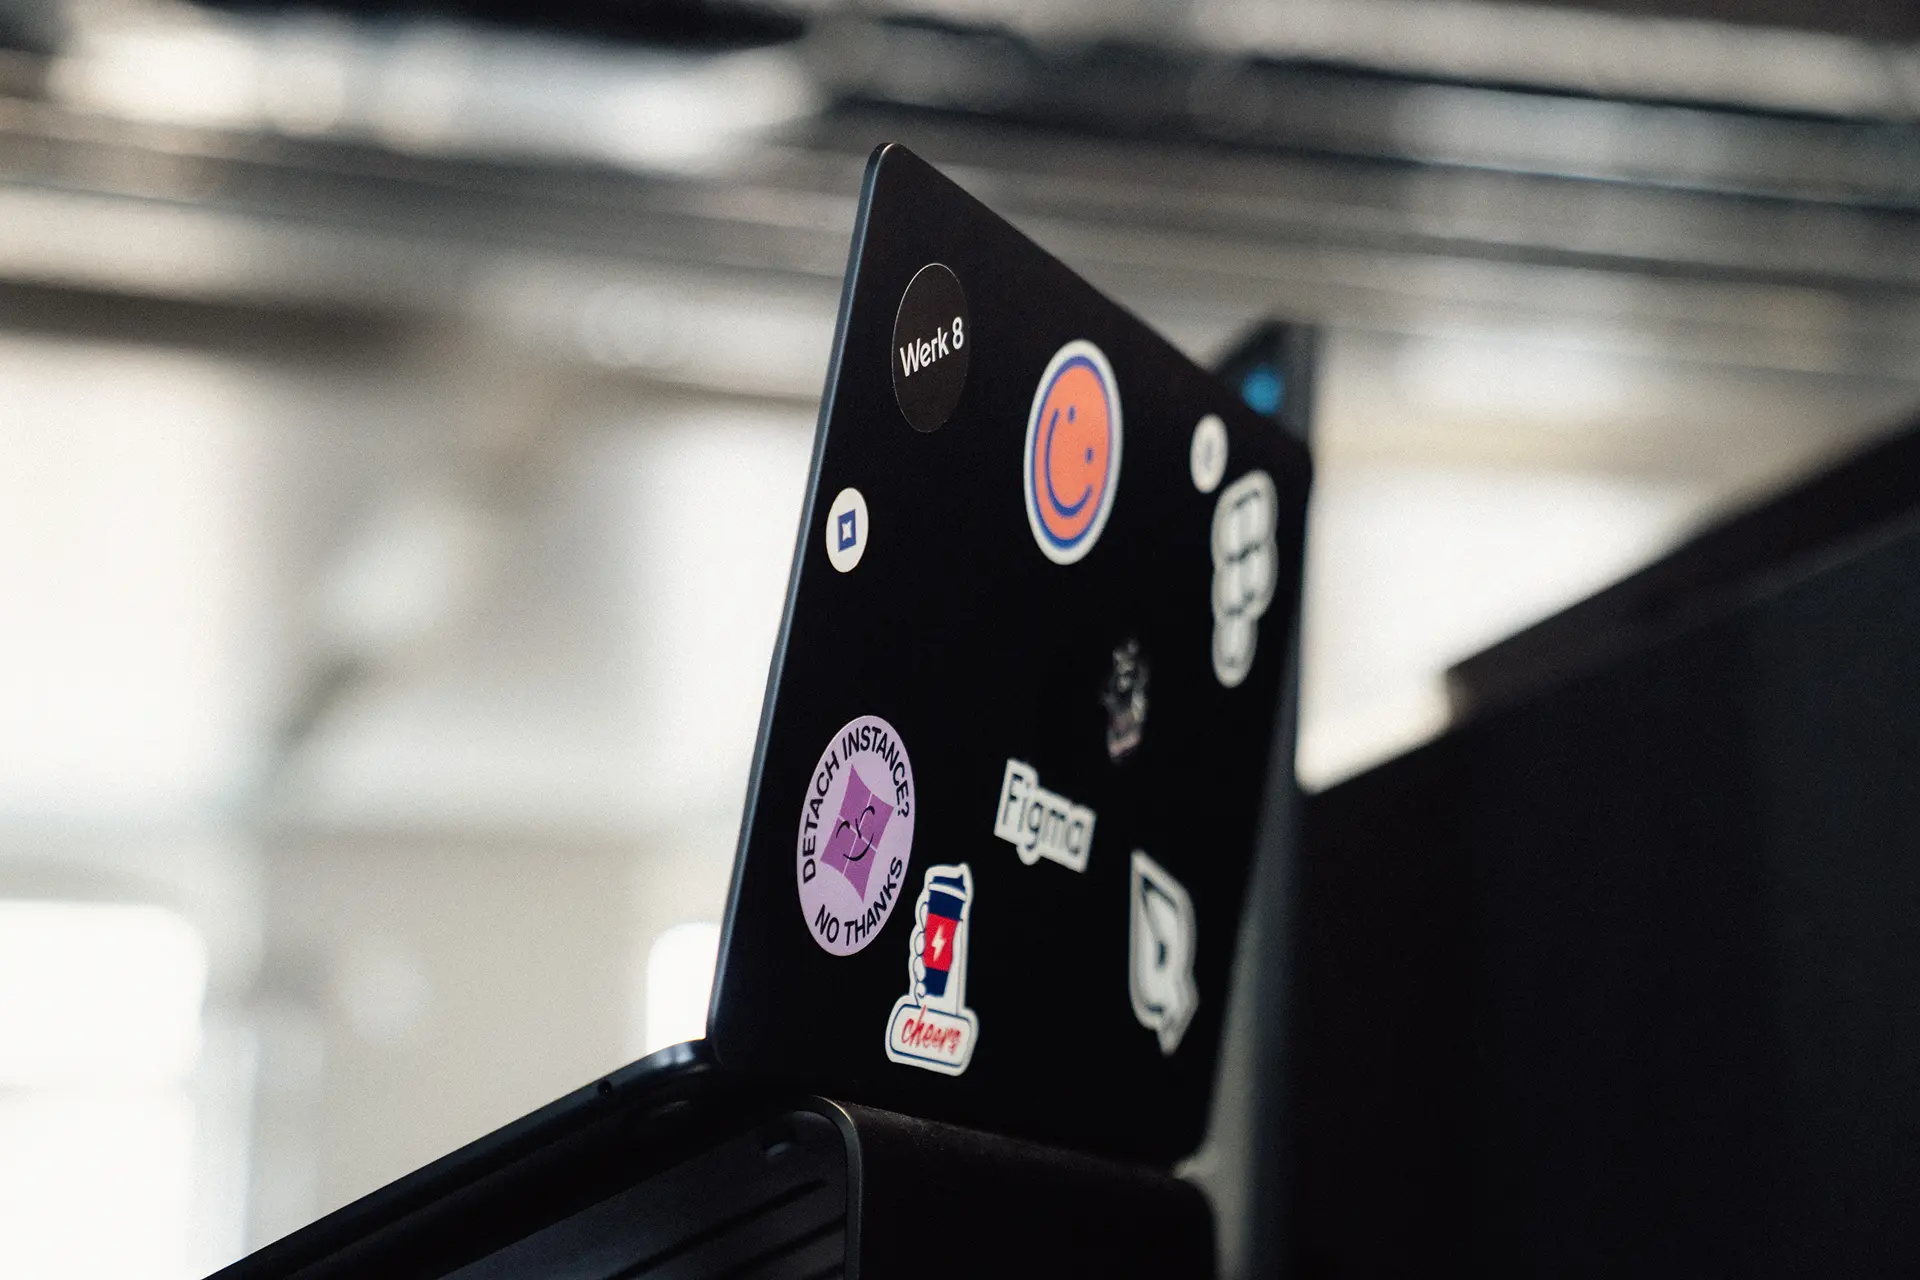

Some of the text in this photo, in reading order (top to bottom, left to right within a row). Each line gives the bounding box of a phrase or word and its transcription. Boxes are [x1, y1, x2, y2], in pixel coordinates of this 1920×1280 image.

[900, 316, 965, 377] Werk 8
[802, 726, 910, 884] DETACH INSTANCE?
[1002, 773, 1084, 857] Figma
[815, 856, 903, 946] NO THANKS
[901, 1005, 961, 1055] cheers
